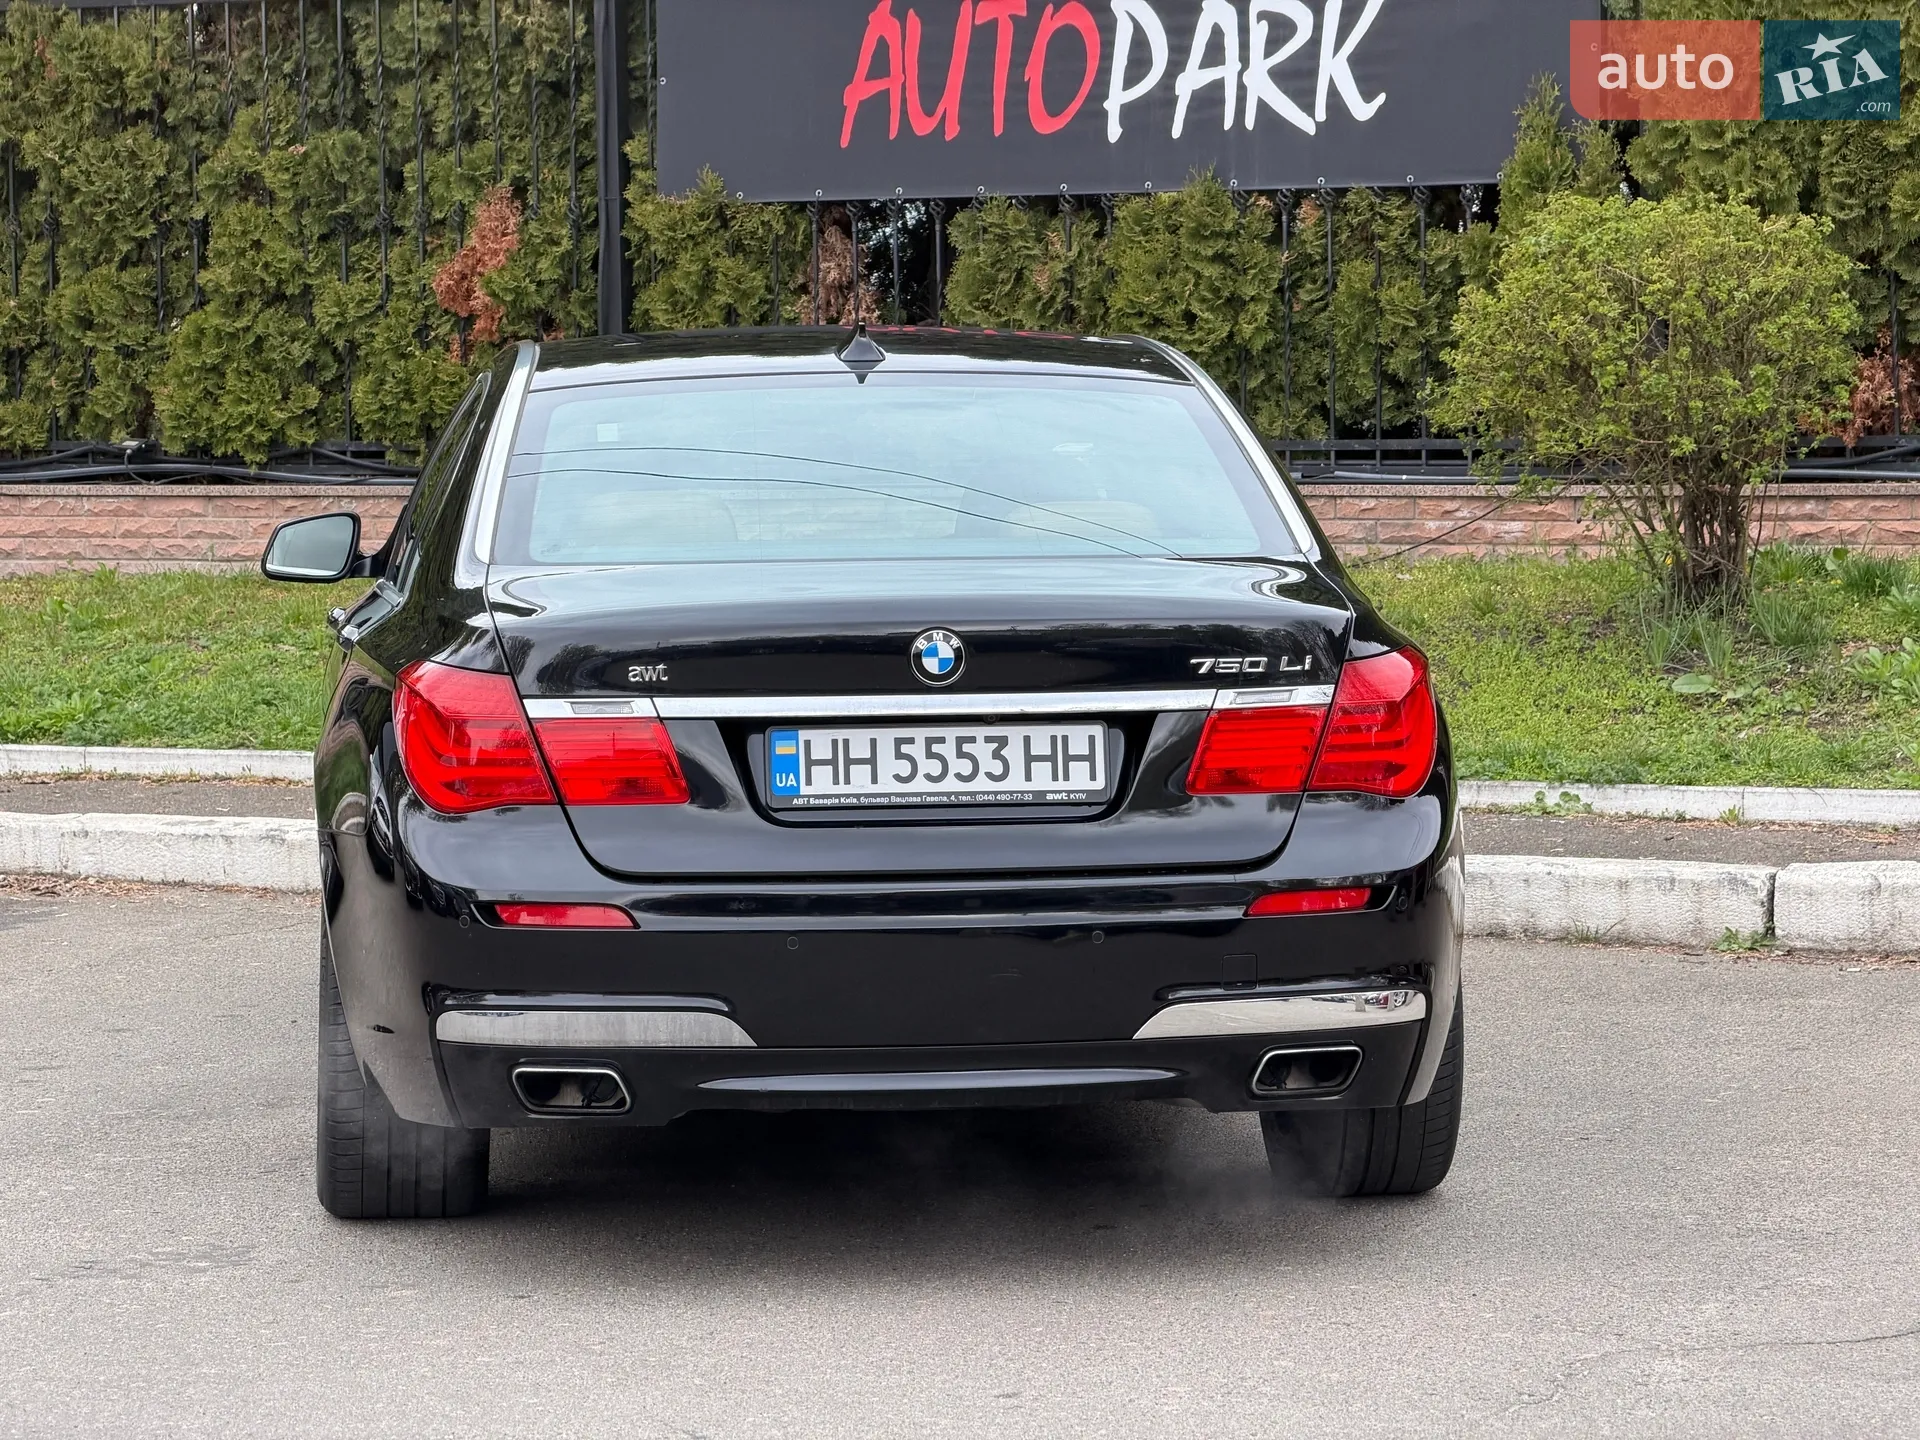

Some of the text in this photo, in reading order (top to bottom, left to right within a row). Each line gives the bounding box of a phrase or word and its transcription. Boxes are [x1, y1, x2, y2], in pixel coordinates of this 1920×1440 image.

[916, 632, 961, 650] BMW
[627, 662, 669, 682] awt
[1190, 657, 1268, 674] 750
[803, 734, 1097, 786] HH 5553 HH
[776, 773, 797, 787] UA
[810, 797, 839, 806] Баварія
[860, 795, 890, 804] бульвар
[890, 795, 921, 803] Вацлава
[950, 794, 957, 802] 4,
[976, 793, 995, 802] (044)
[996, 793, 1033, 801] 490-77-33
[1046, 792, 1087, 800] awt KYIV
